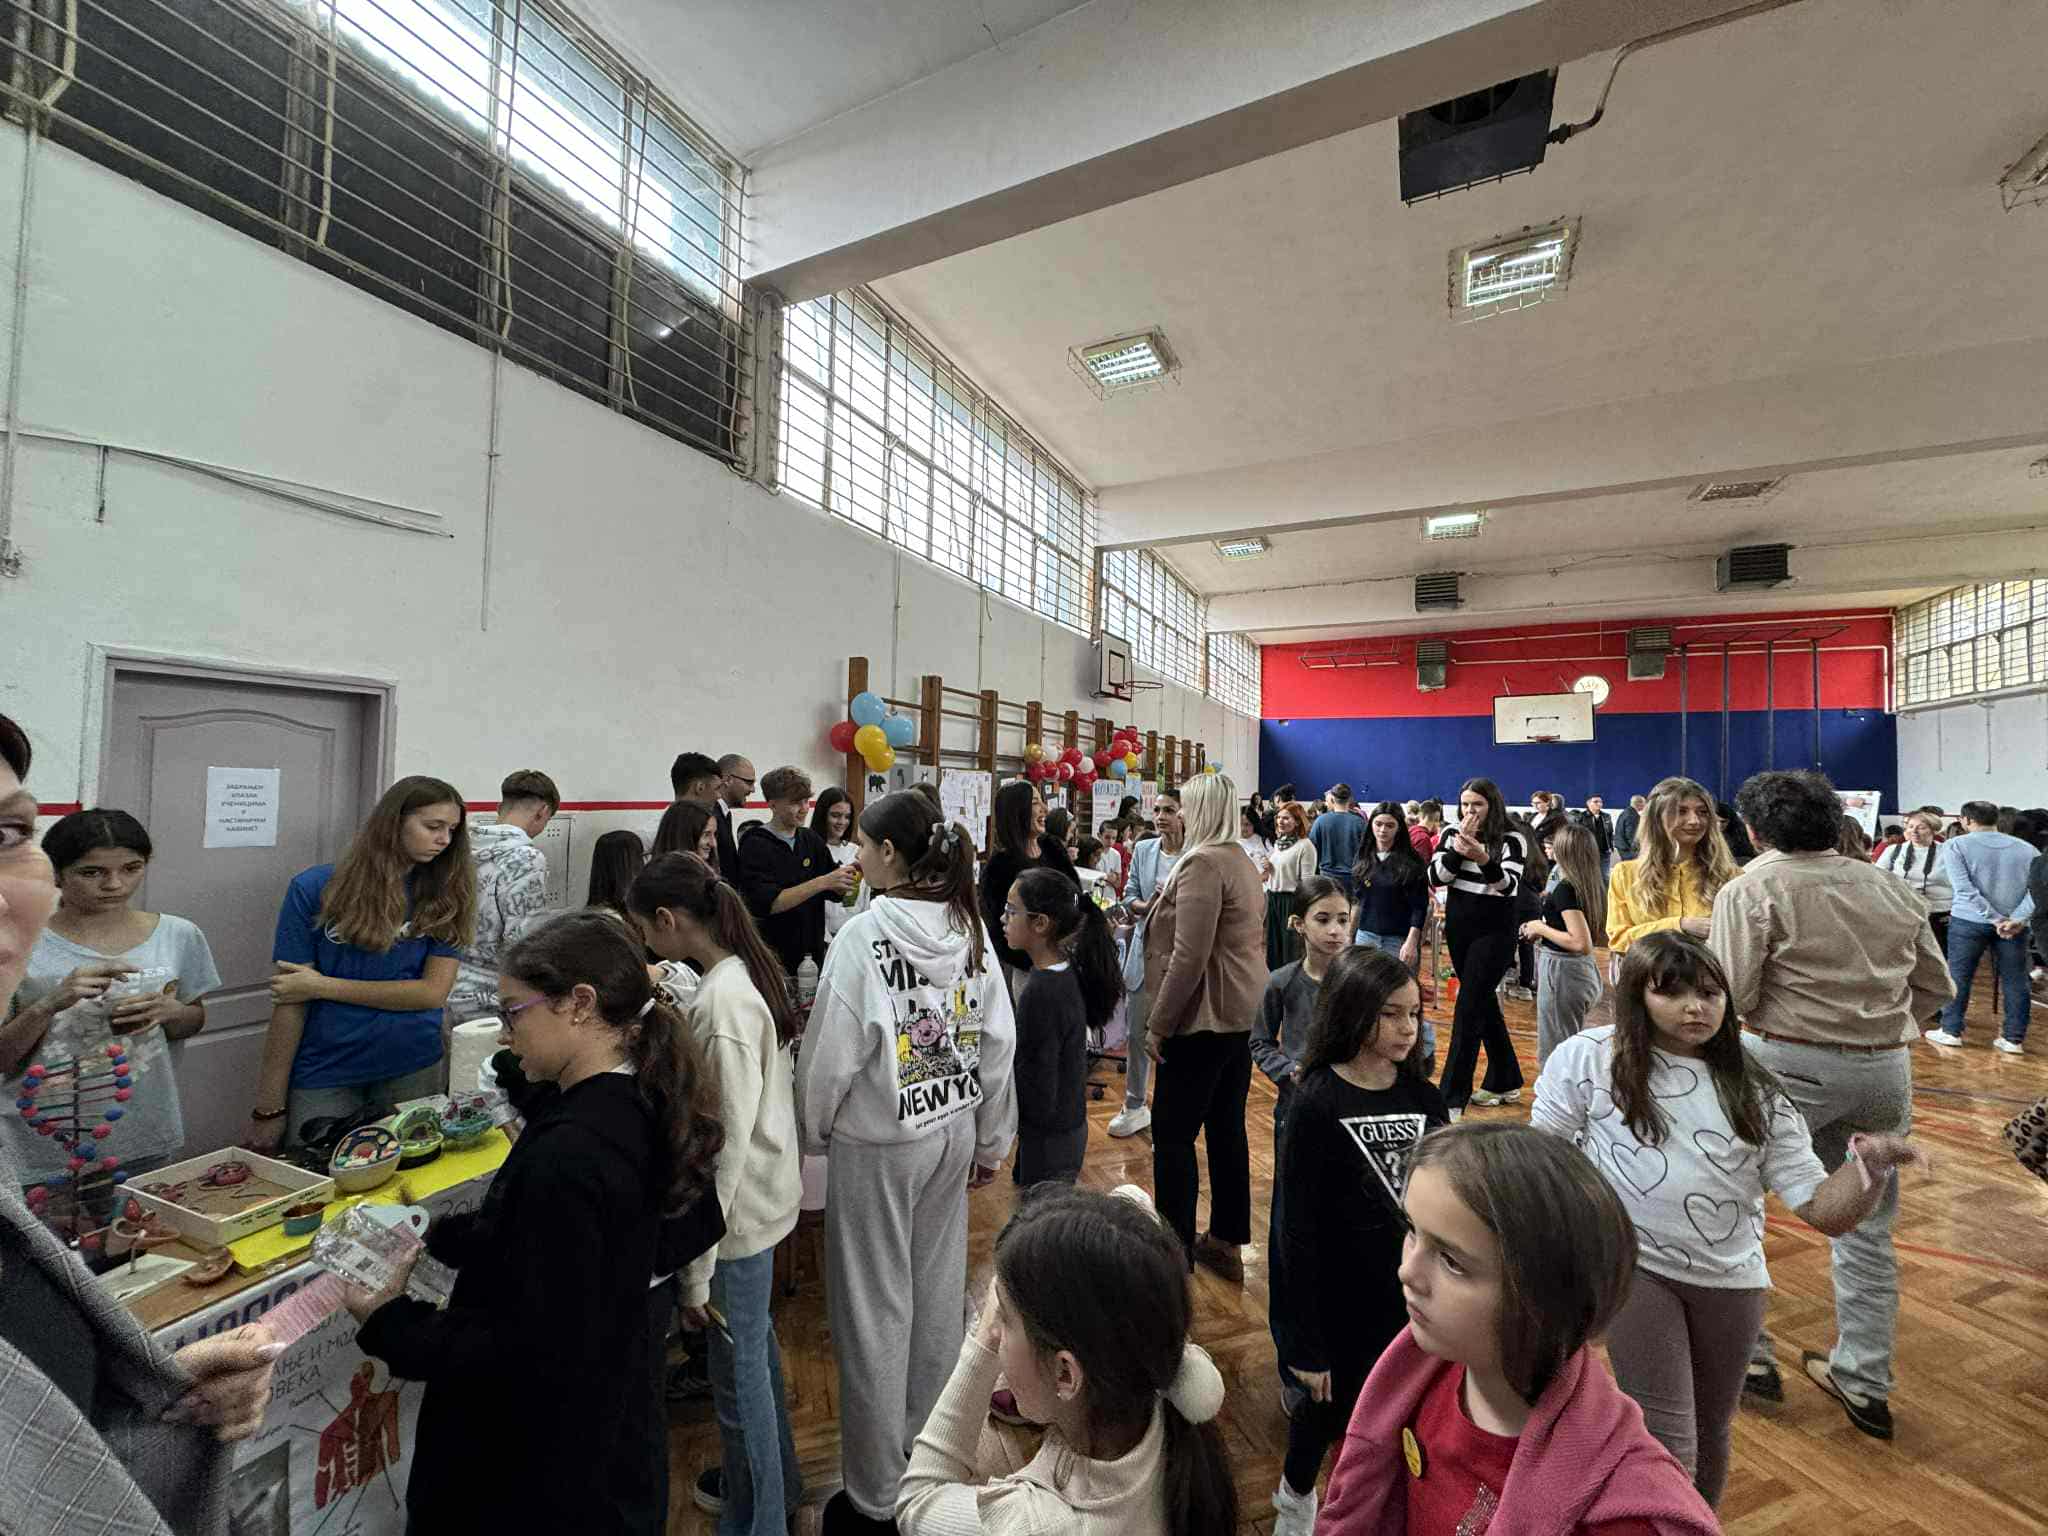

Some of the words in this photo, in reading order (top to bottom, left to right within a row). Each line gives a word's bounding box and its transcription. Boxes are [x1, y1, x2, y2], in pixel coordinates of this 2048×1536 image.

[899, 1077, 951, 1121] NEW
[953, 1067, 980, 1100] YO
[1359, 1121, 1418, 1143] GUESS
